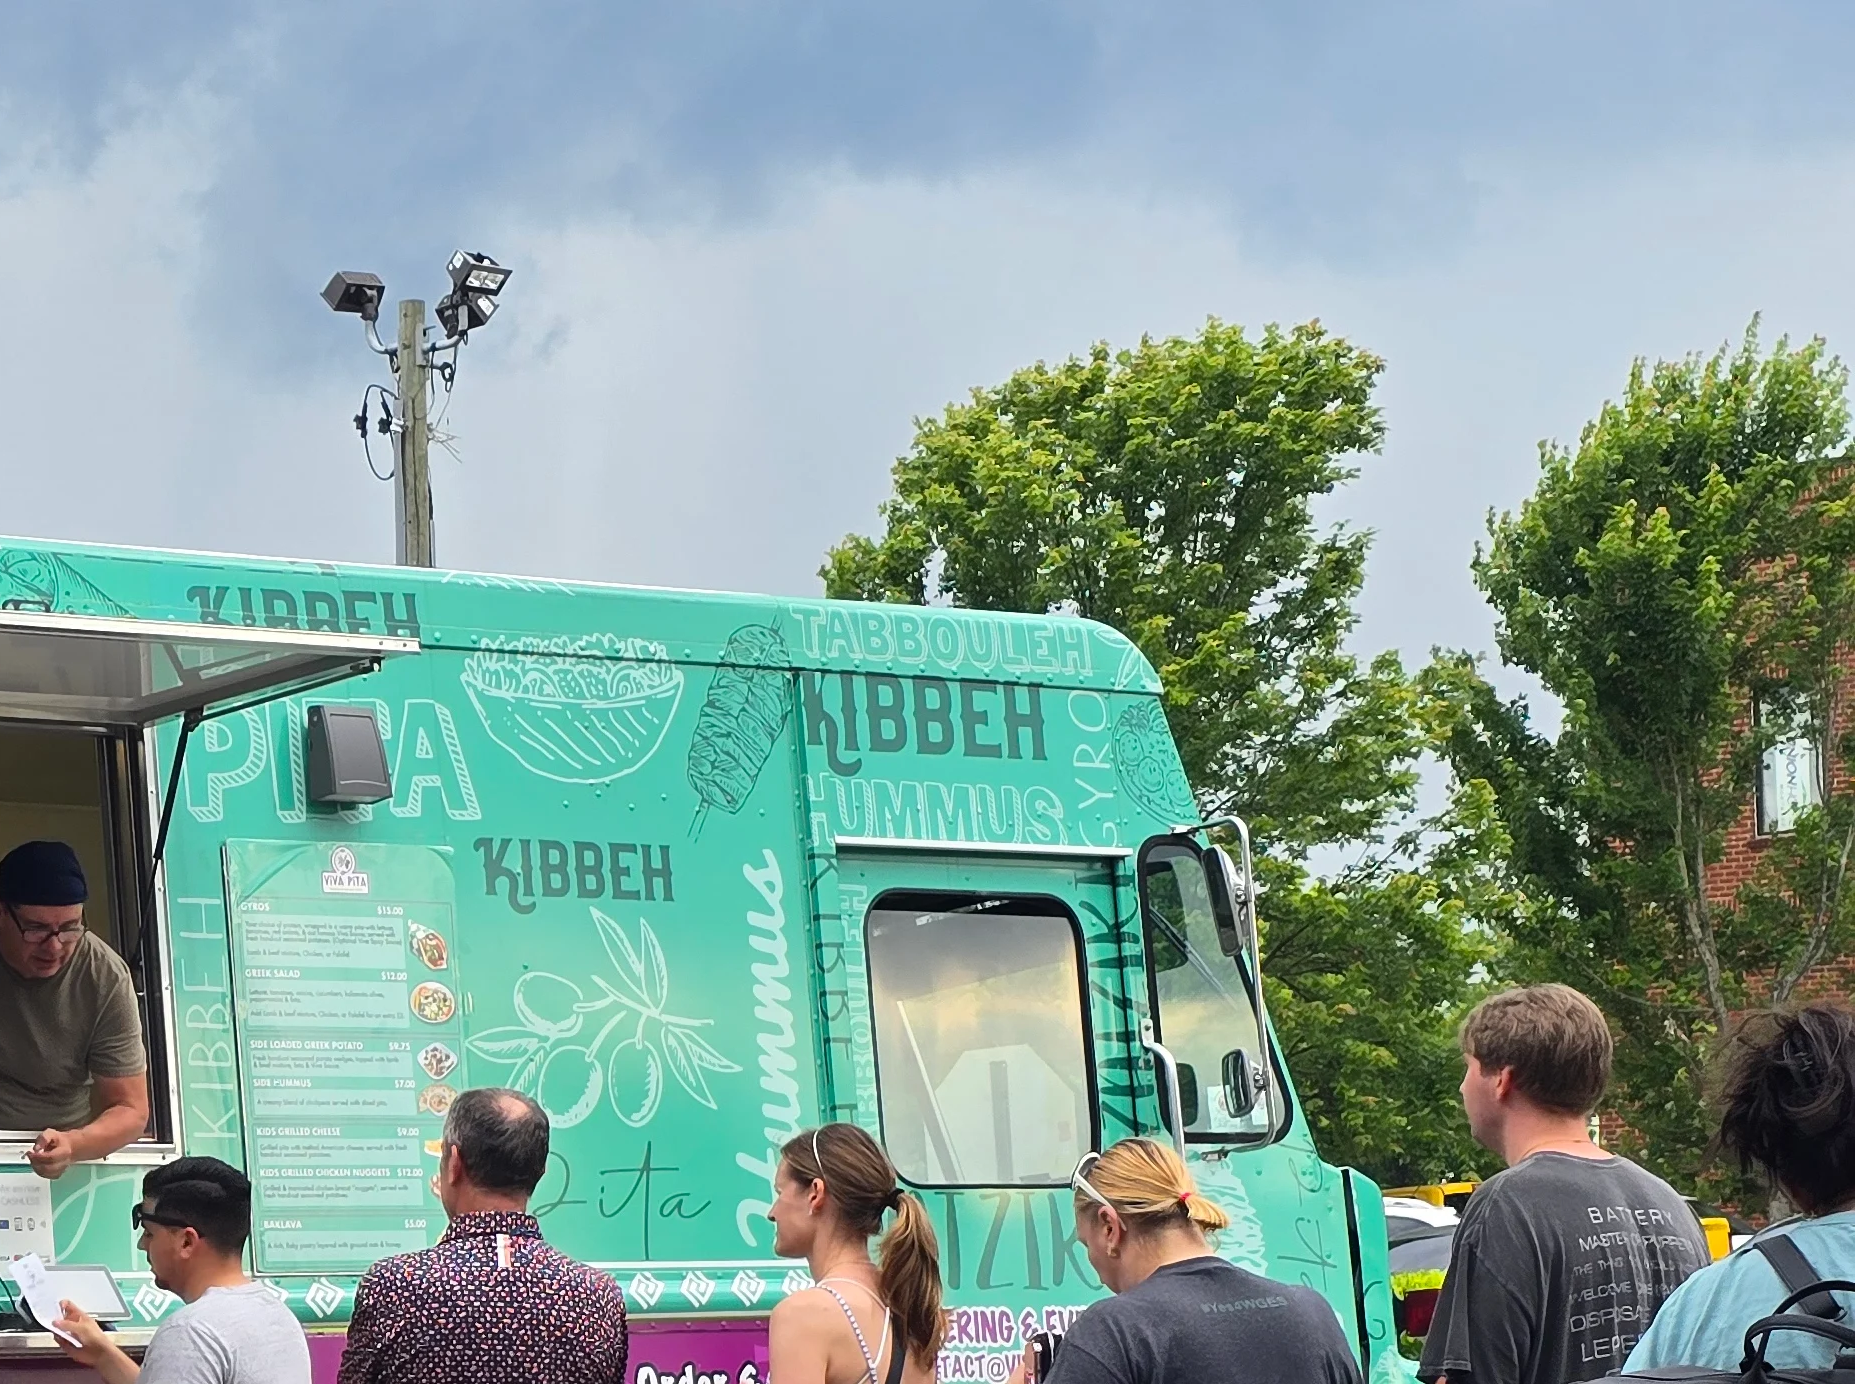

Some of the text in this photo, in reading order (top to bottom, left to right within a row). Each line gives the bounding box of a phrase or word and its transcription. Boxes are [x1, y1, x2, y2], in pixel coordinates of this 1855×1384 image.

[788, 603, 1093, 677] TABBOULEH
[801, 670, 1048, 777] KIBBEH
[181, 697, 482, 823] PIA
[807, 772, 1069, 847] HUMMUS
[473, 836, 675, 915] KIBBEH
[240, 902, 404, 916] GYROS $15.00
[244, 968, 408, 981] GREEK SALAD $12.00
[176, 897, 238, 1139] KIBBEH
[249, 1040, 268, 1050] SIDE
[252, 1078, 271, 1088] SIDE
[394, 1079, 416, 1089] $7.00
[256, 1126, 276, 1136] KIDS
[259, 1168, 280, 1177] KIDS
[263, 1220, 303, 1229] BAKLAVA
[1587, 1206, 1674, 1226] BATTERY
[1581, 1334, 1642, 1363] LEPE
